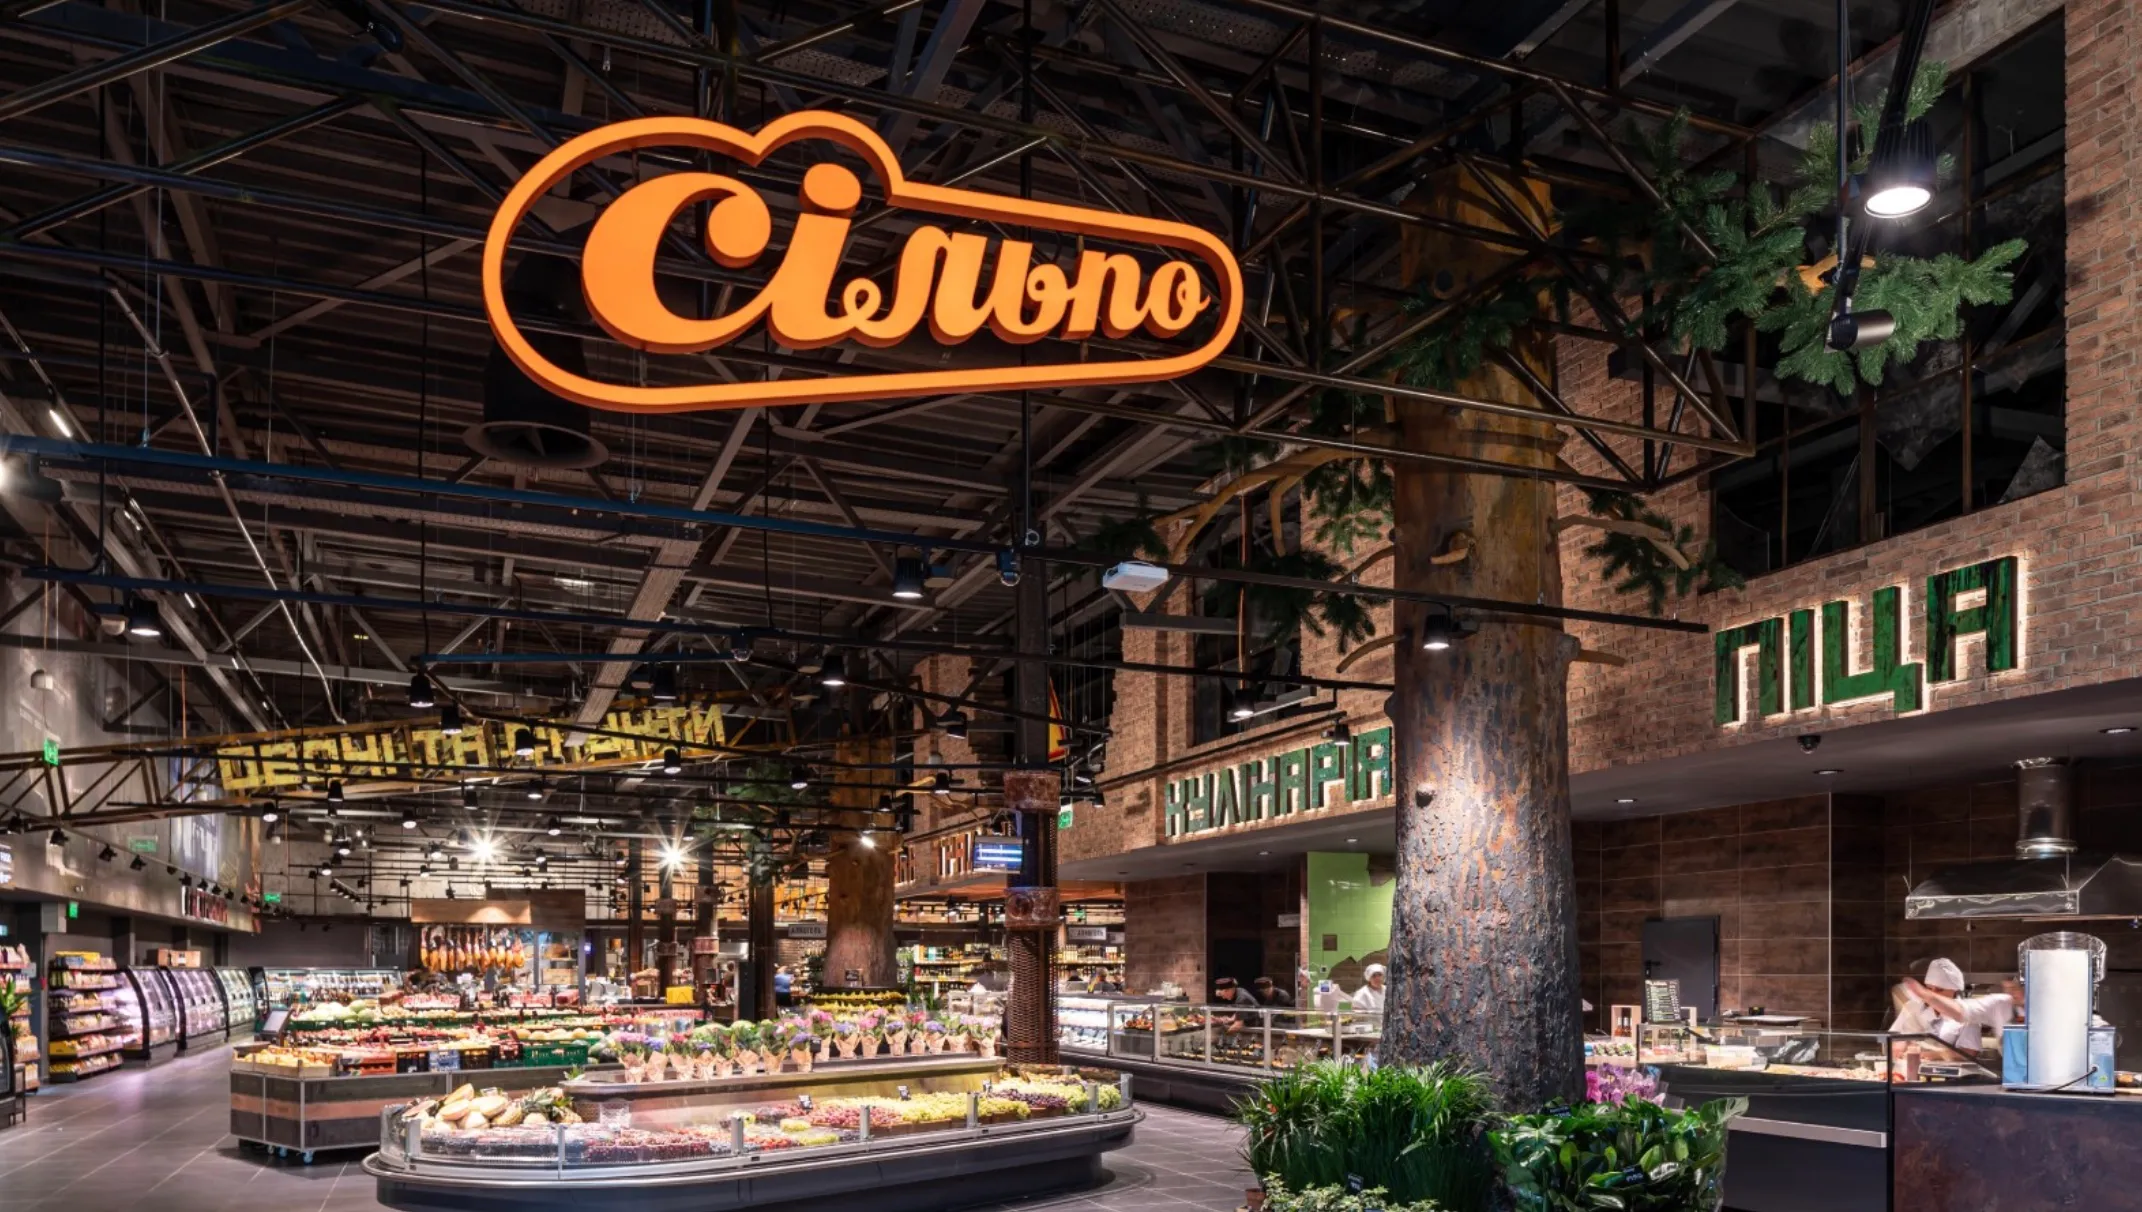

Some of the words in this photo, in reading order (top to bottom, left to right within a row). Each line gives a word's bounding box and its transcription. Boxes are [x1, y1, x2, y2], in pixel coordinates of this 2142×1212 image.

[582, 163, 1209, 352] Сільпо
[1715, 555, 2018, 725] ПІЦА
[1165, 726, 1393, 838] КУЛІНАРІЯ
